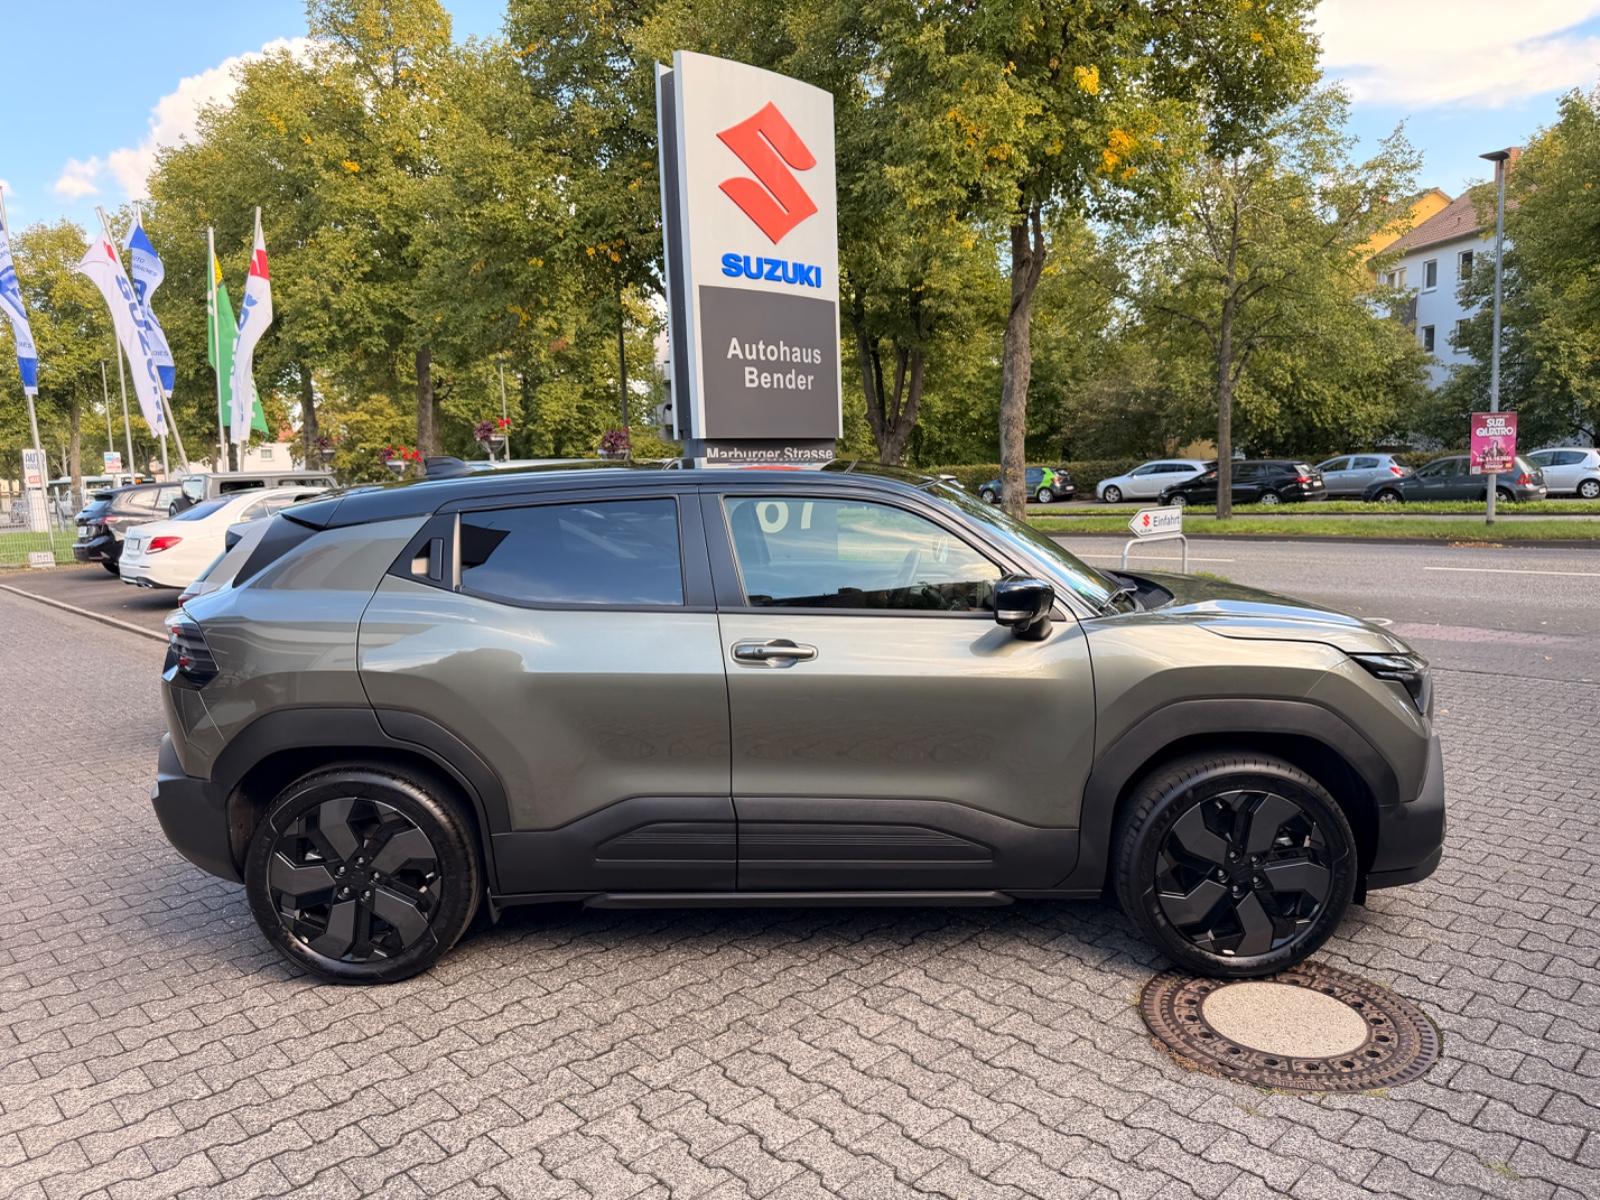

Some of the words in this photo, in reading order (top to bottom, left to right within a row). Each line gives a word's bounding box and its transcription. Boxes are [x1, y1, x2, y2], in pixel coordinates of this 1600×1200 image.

[722, 253, 822, 288] SUZUKI
[727, 337, 822, 364] Autohaus
[744, 366, 814, 390] Bender
[1487, 418, 1505, 427] SUZI
[706, 447, 781, 458] Marburger
[784, 447, 833, 459] Strasse
[1153, 514, 1180, 527] Einfahrt
